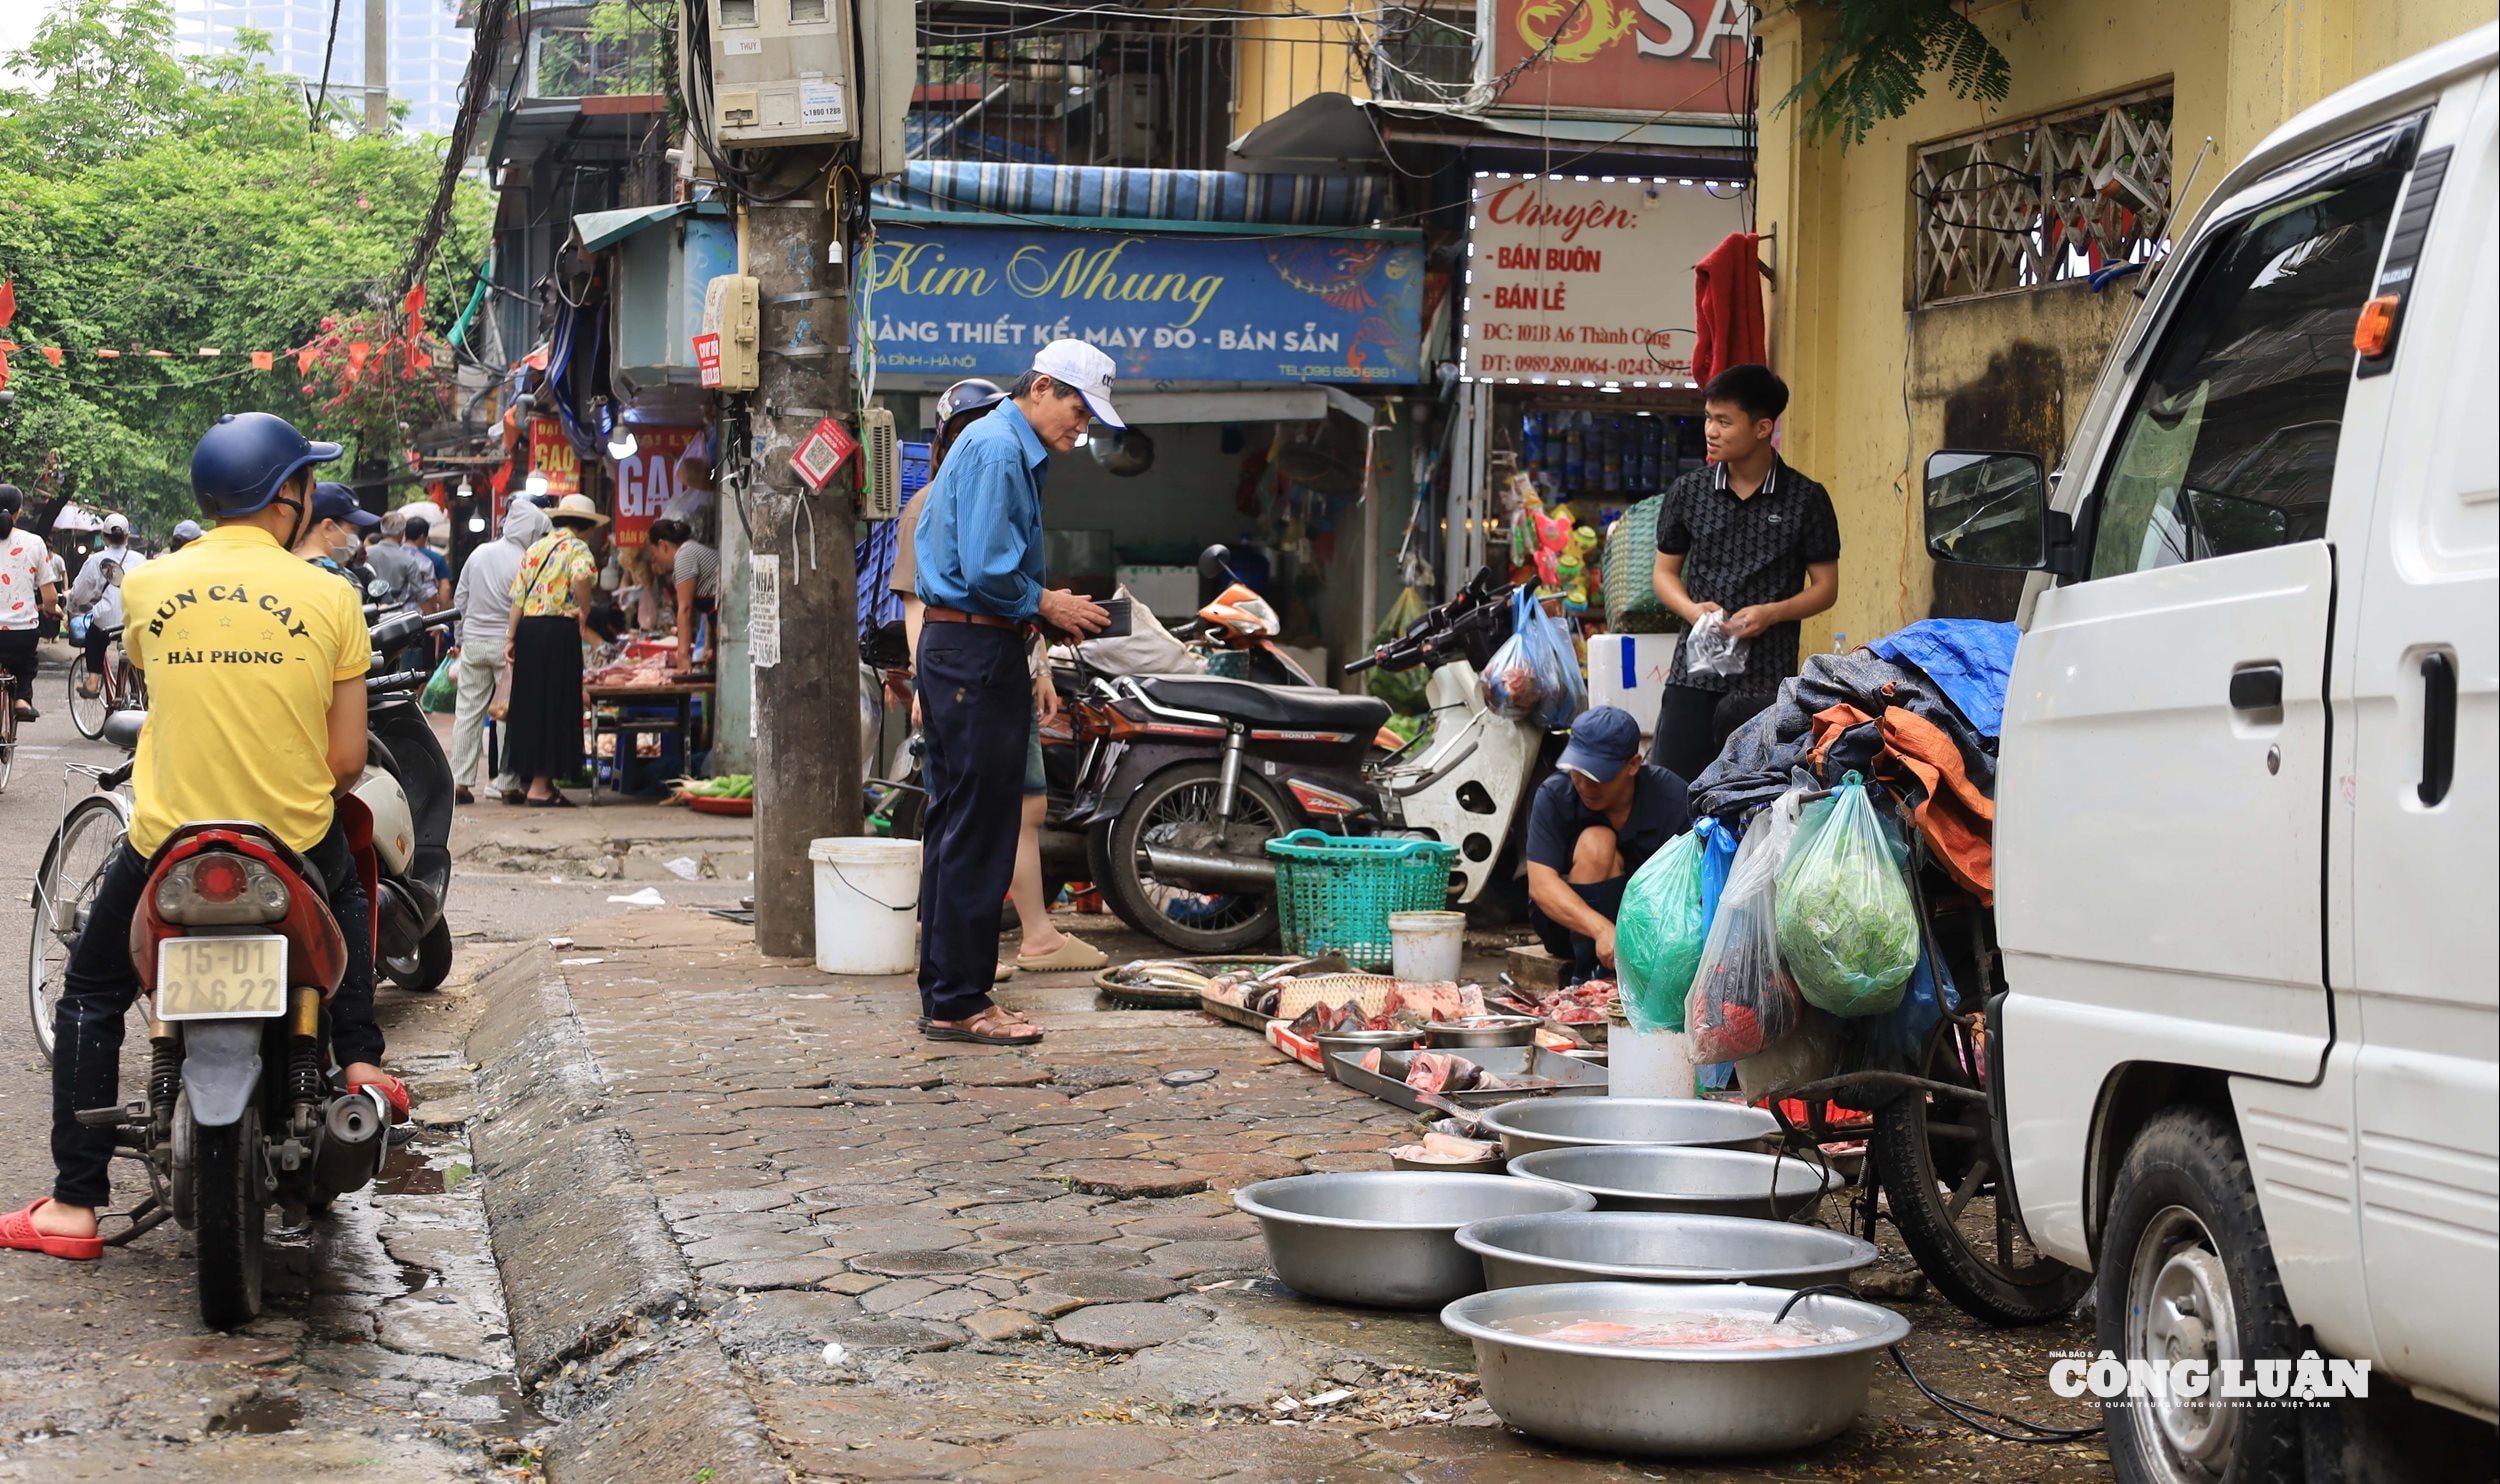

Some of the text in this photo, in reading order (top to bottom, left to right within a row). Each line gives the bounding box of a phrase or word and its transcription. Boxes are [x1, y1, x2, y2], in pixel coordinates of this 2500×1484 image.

[1498, 242, 1539, 270] BÁN
[1545, 245, 1601, 273] BUÔN
[858, 240, 998, 296] Kim
[1007, 237, 1224, 329] Nhung
[2380, 266, 2413, 286] SUZUKI
[1494, 283, 1537, 310] BÁN
[1543, 281, 1567, 311] LẺ
[946, 314, 1026, 345] THIẾT
[1085, 326, 1148, 349] MAY
[1218, 324, 1277, 351] BÁN
[1283, 322, 1340, 352] SẴN
[1484, 323, 1671, 349] ĐC: 101B A6 Thành Công
[1481, 354, 1511, 372] ĐT:
[536, 443, 576, 479] GẠO
[149, 584, 309, 639] BÚN CÁ CAY
[210, 647, 284, 665] PHÒNG
[1280, 732, 1316, 740] HONDA
[181, 941, 265, 975] 15-D1
